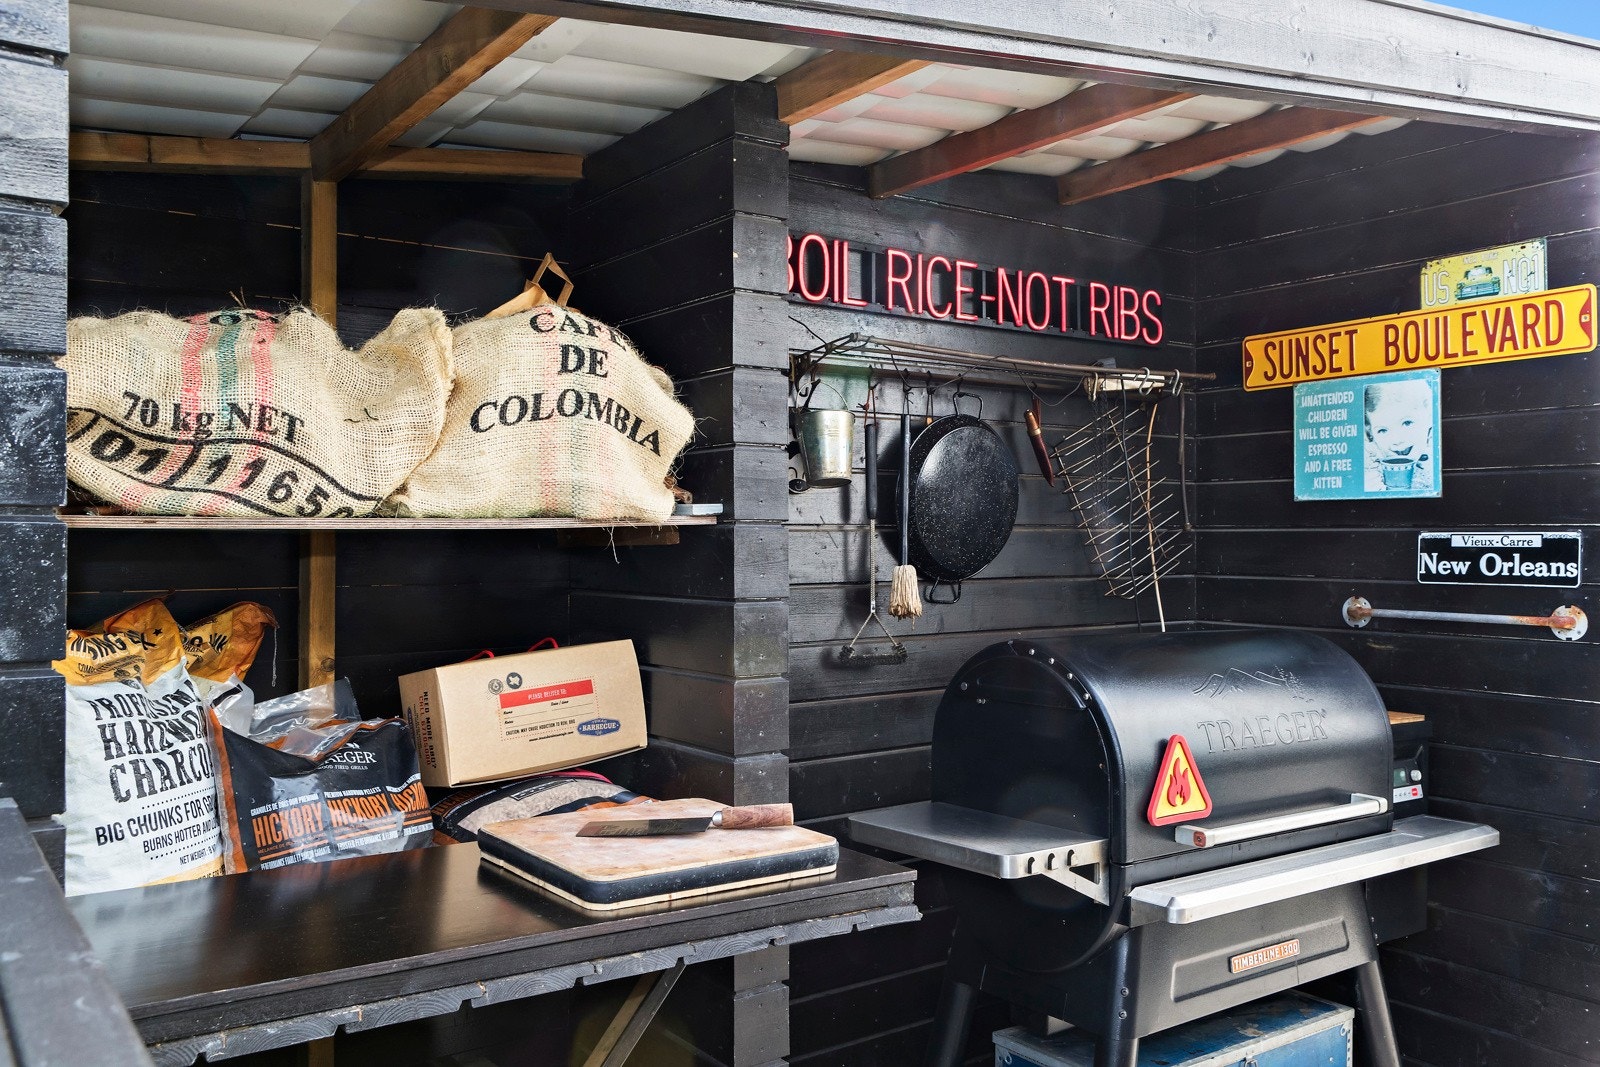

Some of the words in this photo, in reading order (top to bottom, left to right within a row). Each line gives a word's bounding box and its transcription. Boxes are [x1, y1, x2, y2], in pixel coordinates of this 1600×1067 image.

[788, 234, 867, 307] OIL
[1089, 281, 1164, 345] RIBS
[1423, 270, 1450, 307] US
[1263, 329, 1358, 382] SUNSET
[1384, 300, 1564, 366] BOULEVARD
[558, 343, 609, 378] DE
[1301, 391, 1355, 408] UNATTENDED
[1307, 408, 1348, 424] CHILDREN
[122, 391, 160, 428] 70
[171, 403, 214, 439] kg
[226, 402, 305, 444] NET
[470, 388, 662, 457] COLOMBIA
[1299, 428, 1318, 441] WILL
[1320, 426, 1330, 440] BE
[1332, 424, 1358, 439] GIVEN
[1304, 461, 1320, 473] AND
[1323, 460, 1330, 472] A
[1331, 459, 1352, 471] FREE
[1308, 443, 1348, 457] ESPRESSO
[1313, 476, 1343, 489] KITTEN
[1419, 552, 1471, 575] New
[1479, 552, 1578, 577] Orleans
[425, 716, 433, 740] MORE
[582, 722, 617, 732] BARBECUE
[1197, 708, 1329, 753] TRAEGER
[109, 742, 214, 803] CHARCO
[95, 821, 125, 847] BIG
[126, 804, 183, 838] CHUNKS
[184, 797, 205, 821] FOR
[251, 801, 325, 849] HICKORY
[326, 792, 393, 827] HICKORY
[143, 833, 173, 853] BURNS
[174, 823, 202, 843] HOTTER
[202, 818, 212, 835] AND
[179, 855, 190, 865] NET
[1233, 947, 1281, 971] TIMBERLINE
